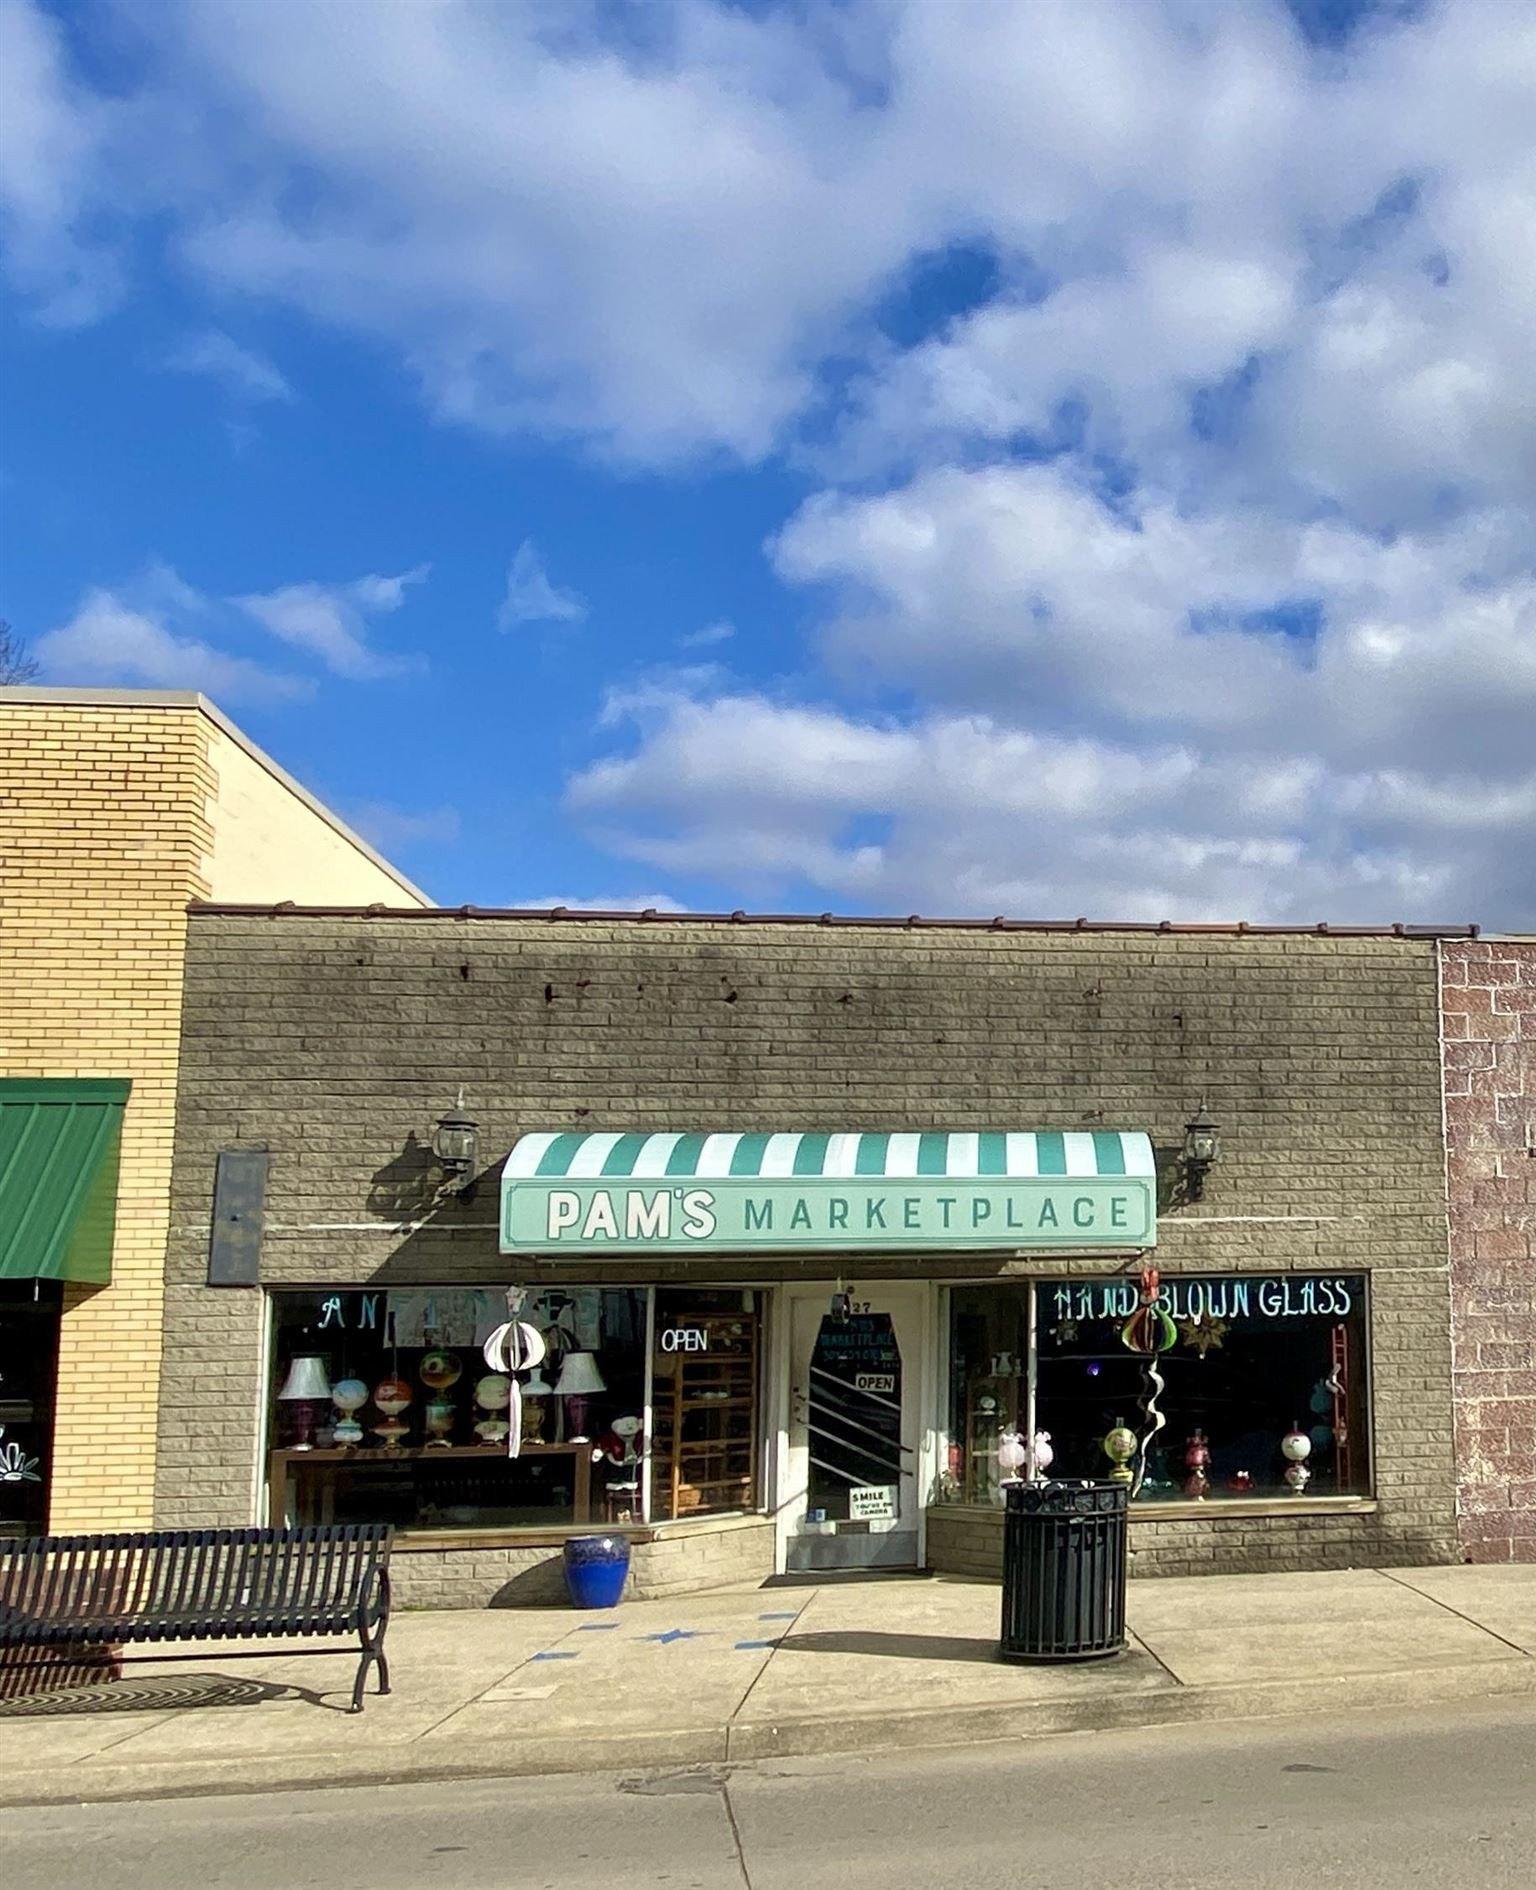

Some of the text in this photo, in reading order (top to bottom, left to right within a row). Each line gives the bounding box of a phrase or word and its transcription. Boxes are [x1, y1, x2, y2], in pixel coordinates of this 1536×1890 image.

[546, 1186, 1129, 1240] PAM'S MARKETPLACE
[1053, 1276, 1352, 1324] HAND BLOWN GLASS
[661, 1329, 708, 1351] OPEN
[858, 1376, 892, 1390] OPEN
[852, 1492, 883, 1502] SMILE
